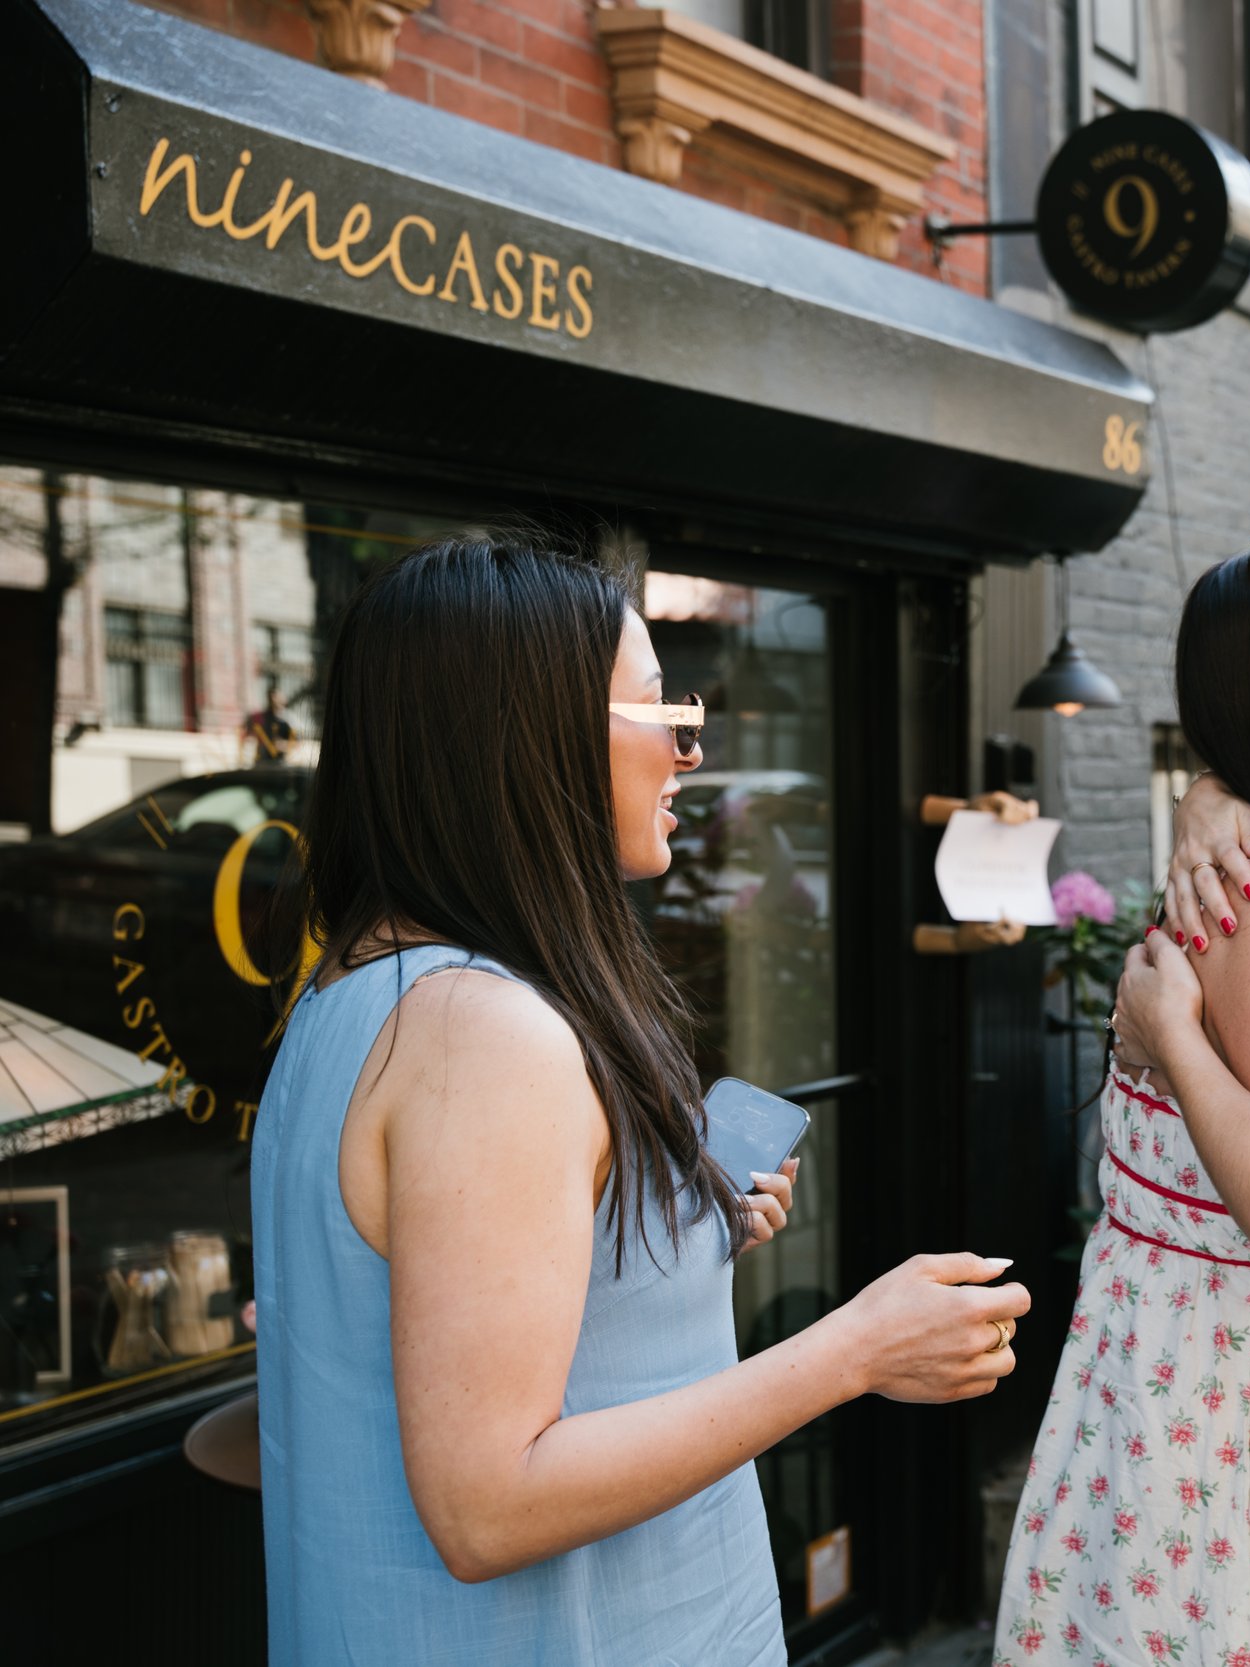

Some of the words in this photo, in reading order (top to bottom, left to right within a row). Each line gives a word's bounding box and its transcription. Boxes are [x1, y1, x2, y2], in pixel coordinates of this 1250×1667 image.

[1090, 142, 1138, 172] NINE
[1142, 145, 1195, 194] CASES
[1067, 213, 1120, 285] GASTRO
[1122, 237, 1192, 288] TAVERN
[1103, 174, 1159, 259] 9
[1103, 414, 1141, 475] 86
[112, 903, 216, 1124] GASTRO
